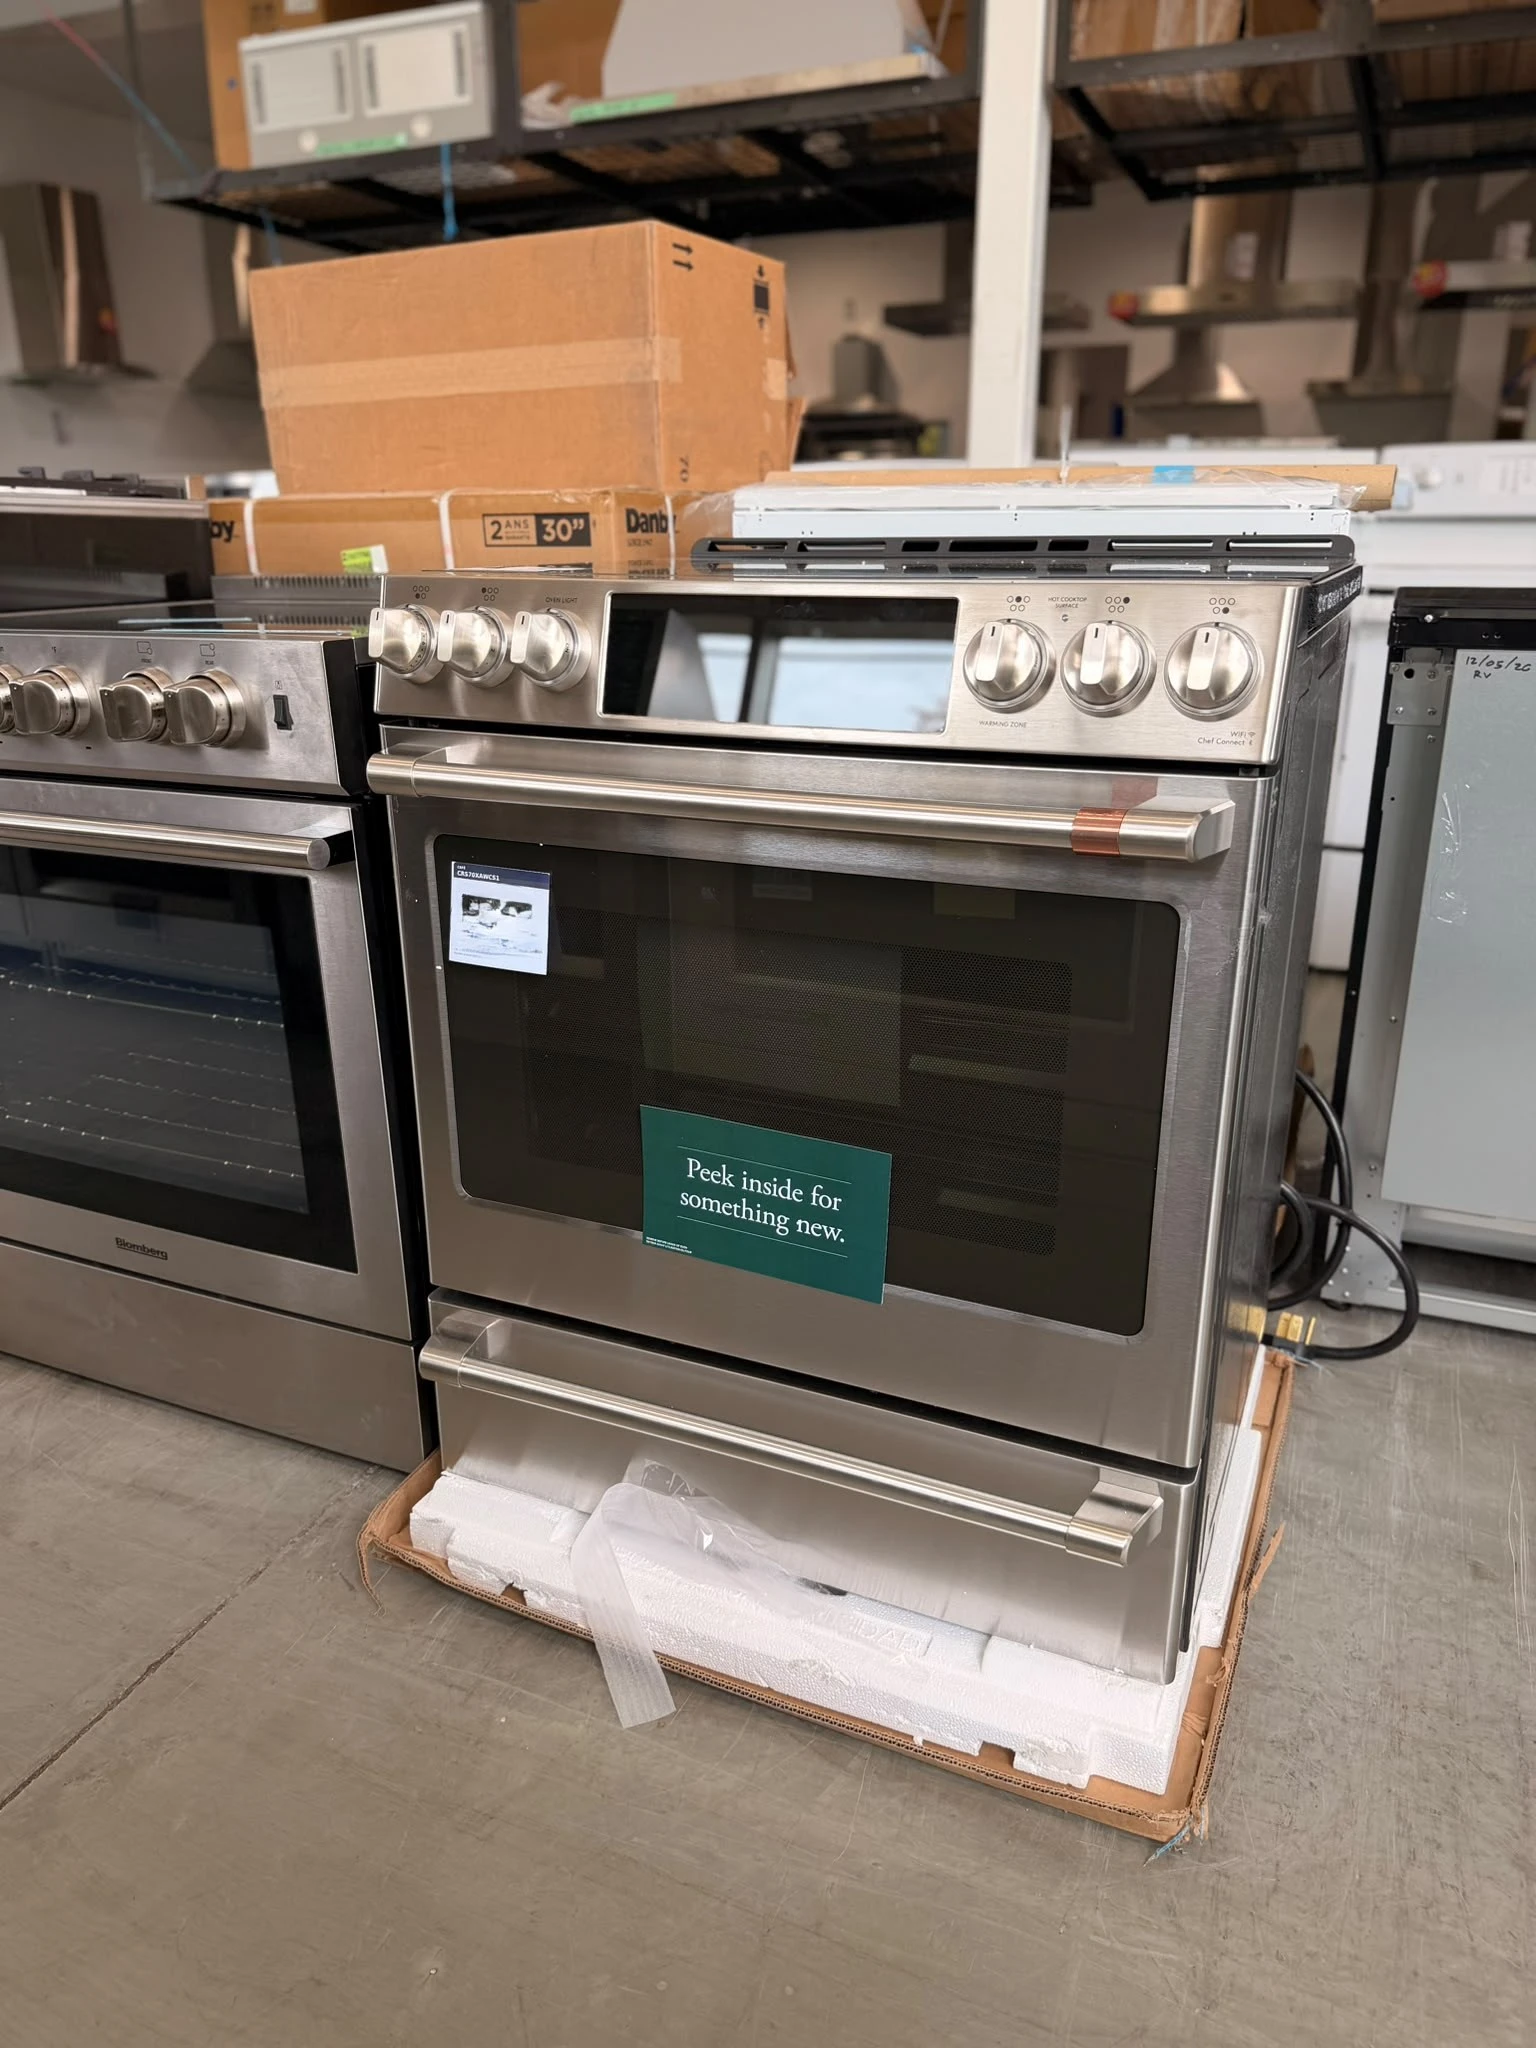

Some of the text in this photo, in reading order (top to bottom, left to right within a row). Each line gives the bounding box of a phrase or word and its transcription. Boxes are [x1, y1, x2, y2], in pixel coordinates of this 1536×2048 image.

[490, 517, 530, 541] 2 ANS
[1010, 721, 1028, 729] ZONE
[1216, 738, 1245, 746] Connect
[686, 1157, 843, 1212] Peek inside for
[679, 1191, 846, 1243] something new.
[115, 1236, 169, 1261] Blomberg
